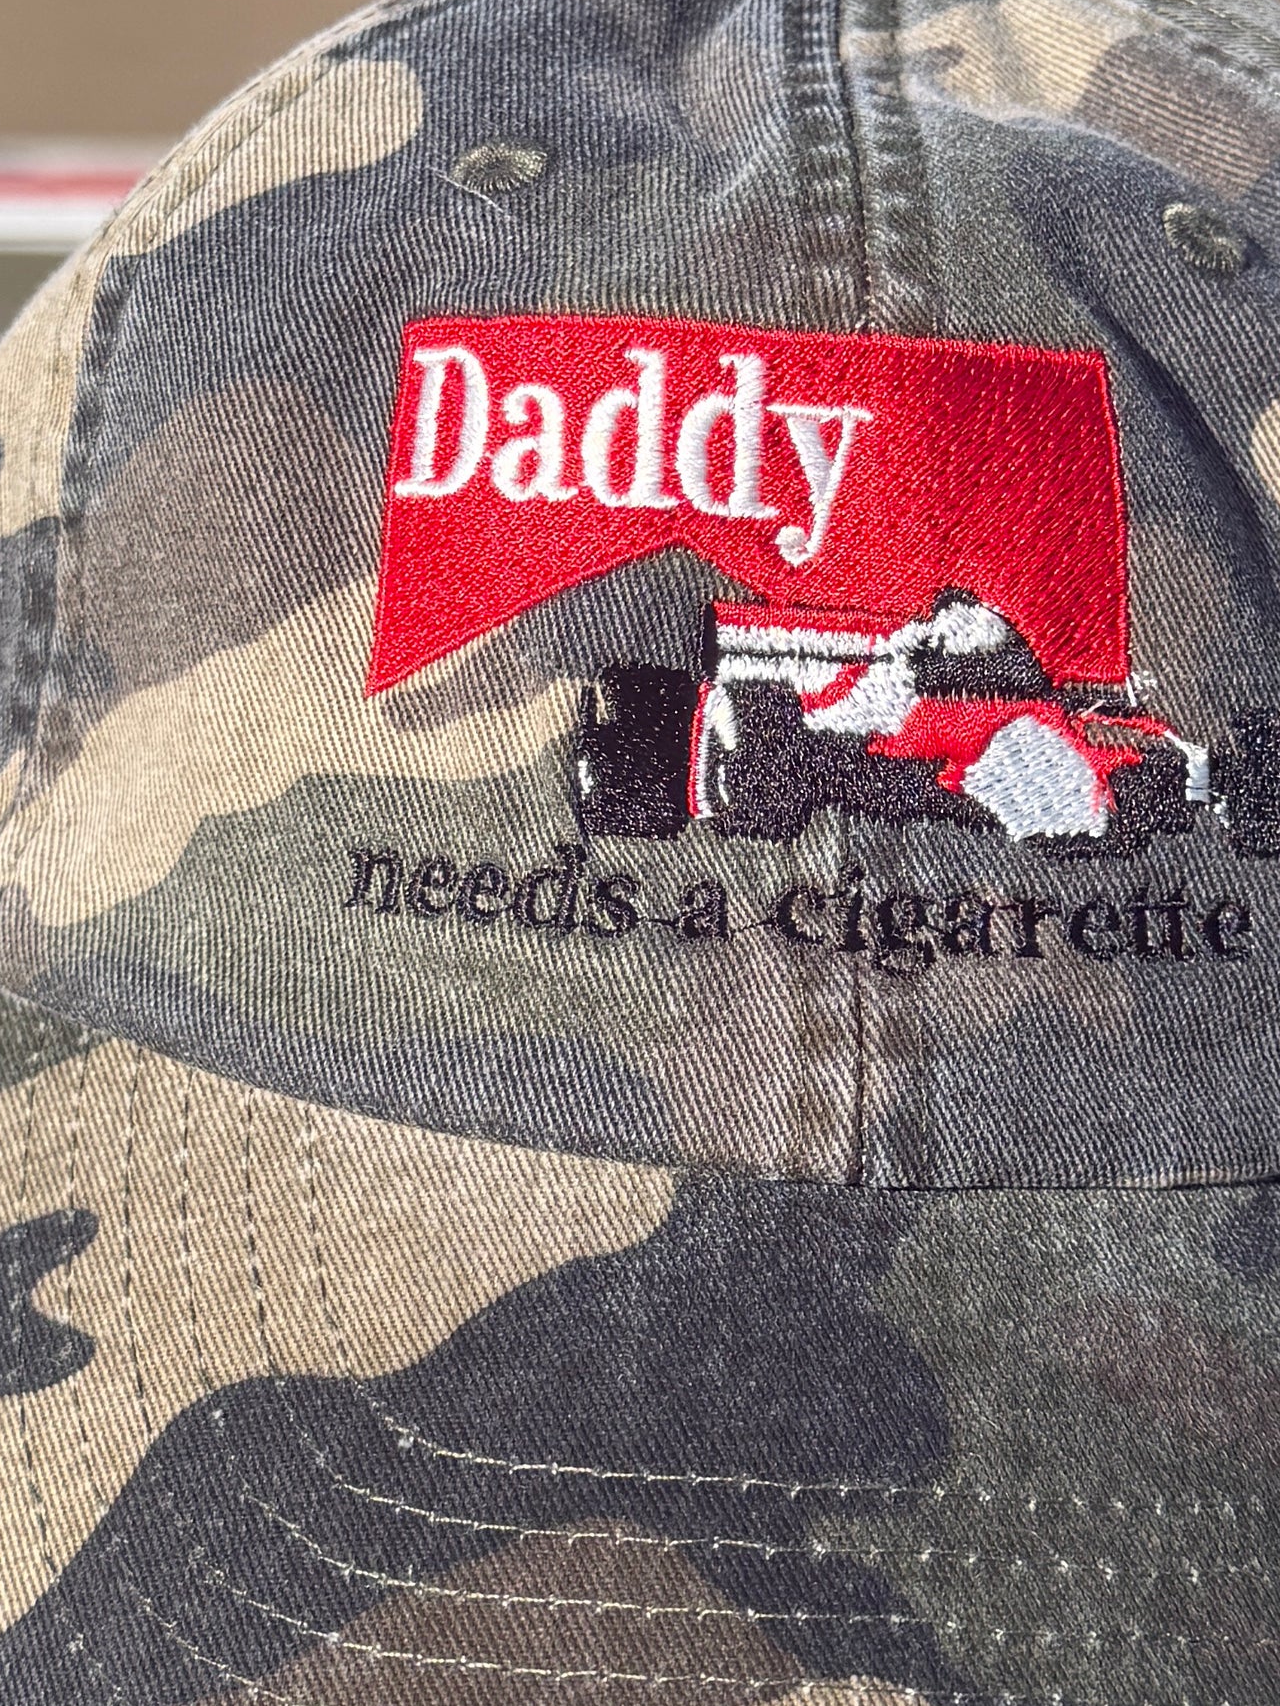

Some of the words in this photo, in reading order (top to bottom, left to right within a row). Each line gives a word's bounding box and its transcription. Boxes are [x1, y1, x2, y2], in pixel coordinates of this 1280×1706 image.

[394, 346, 874, 567] Daddy
[345, 842, 640, 939] needs
[676, 877, 730, 941] a
[773, 861, 1254, 977] cigarette
